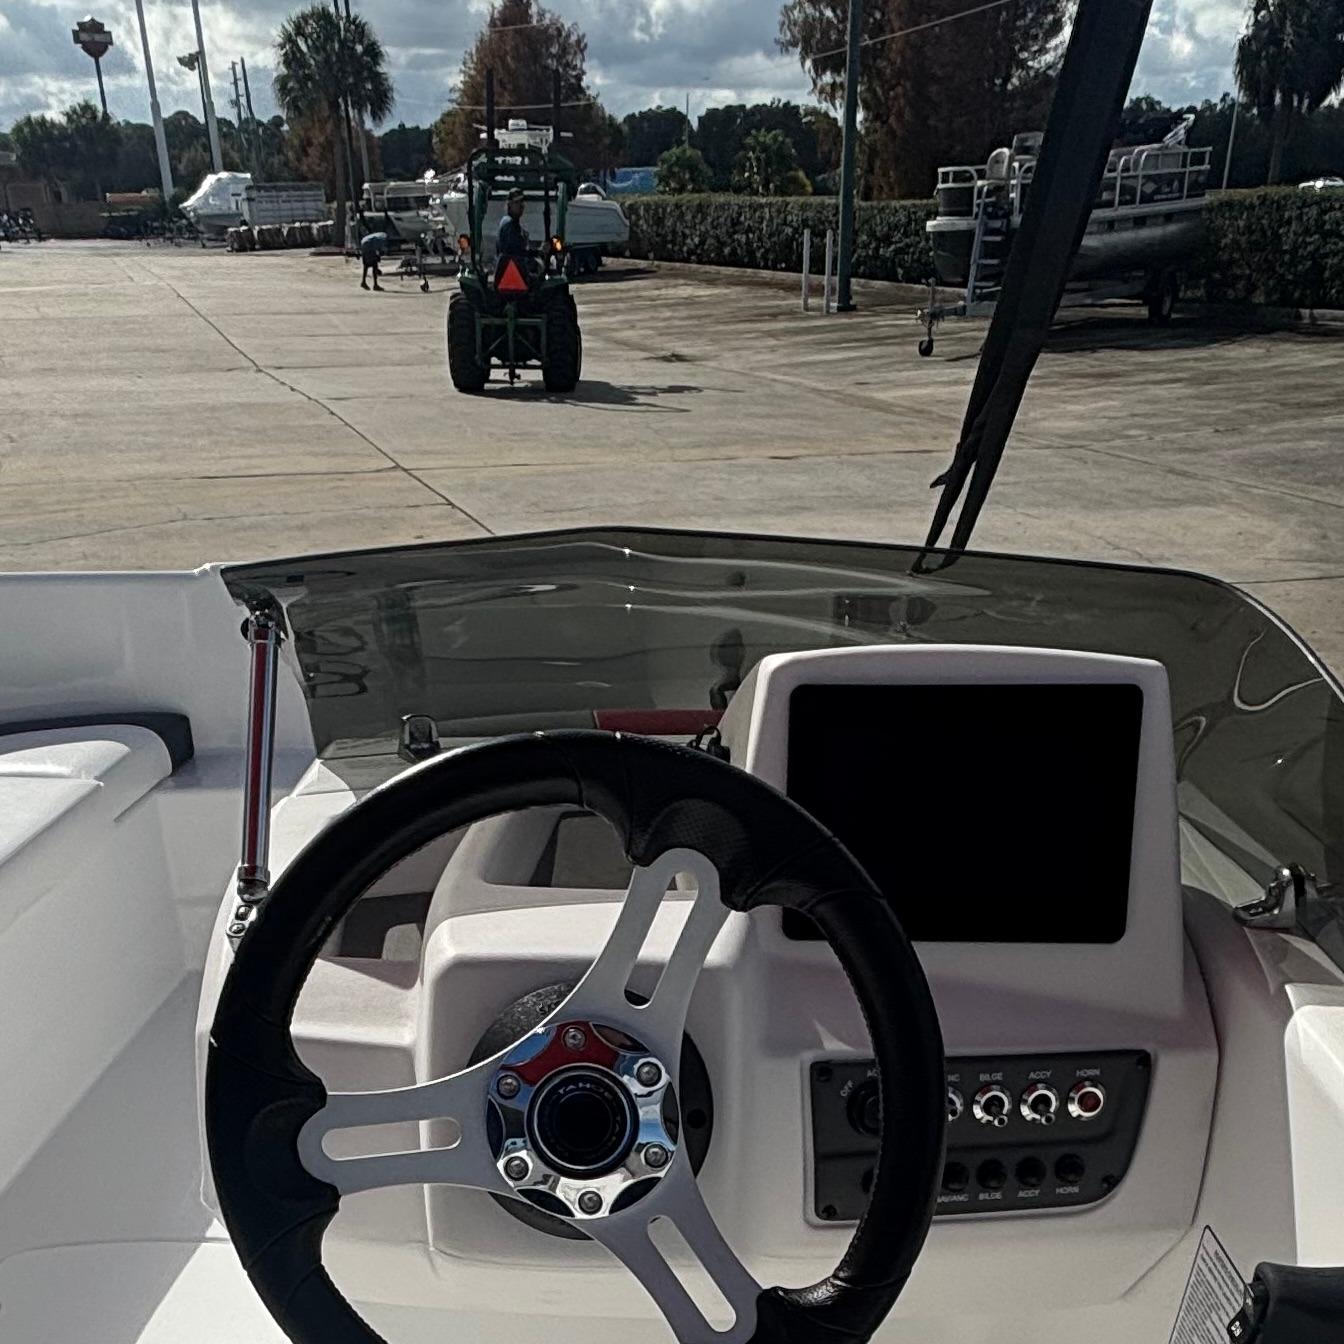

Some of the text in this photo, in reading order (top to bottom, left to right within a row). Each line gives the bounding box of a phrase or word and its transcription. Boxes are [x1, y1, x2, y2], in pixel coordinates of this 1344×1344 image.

[840, 1080, 855, 1097] OFF
[979, 1072, 1004, 1081] BILGE
[1028, 1069, 1053, 1080] ACCY
[1076, 1068, 1101, 1078] HORN
[978, 1191, 1003, 1201] BILGE
[1017, 1189, 1041, 1198] ACCY
[1056, 1185, 1080, 1195] HORN
